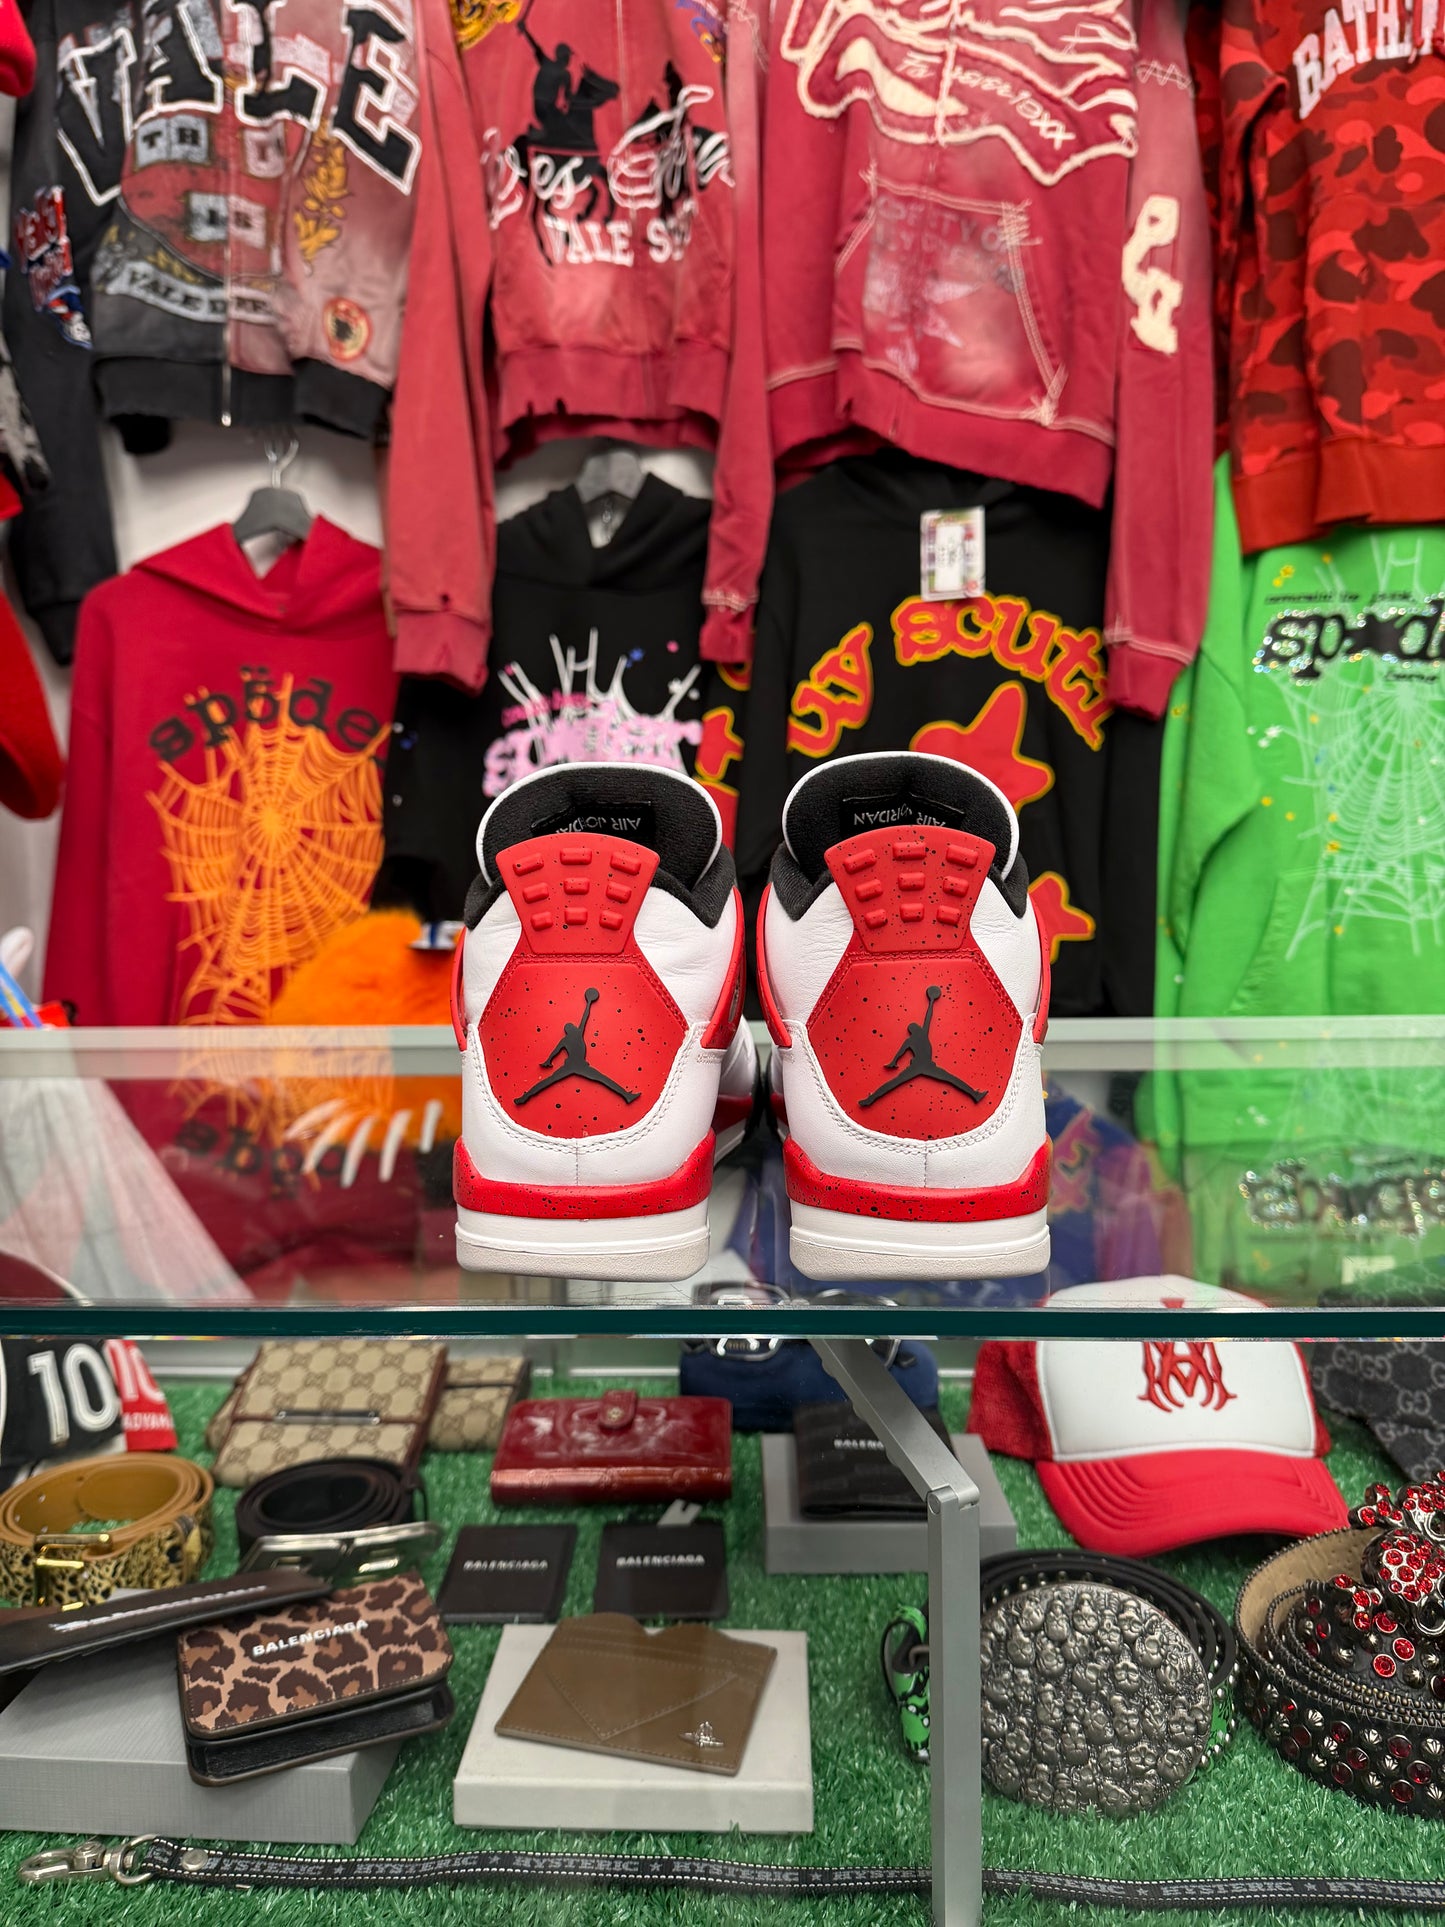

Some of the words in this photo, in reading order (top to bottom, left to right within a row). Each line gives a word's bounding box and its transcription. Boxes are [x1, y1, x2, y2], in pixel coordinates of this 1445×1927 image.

[544, 216, 634, 267] VALE
[611, 817, 641, 831] AIR
[27, 1343, 122, 1446] 10
[463, 1559, 548, 1571] BALENCIAGA
[615, 1554, 705, 1568] BALENCIAGA
[252, 1618, 368, 1658] BALENCIAGA
[203, 1856, 324, 1876] HYSTERIC
[354, 1855, 478, 1875] HYSTERIC
[513, 1854, 639, 1873] HYSTERIC
[671, 1861, 799, 1883] HYSTERIC
[994, 1870, 1126, 1897] HYSTERIC
[1162, 1880, 1294, 1897] HYSTERIC
